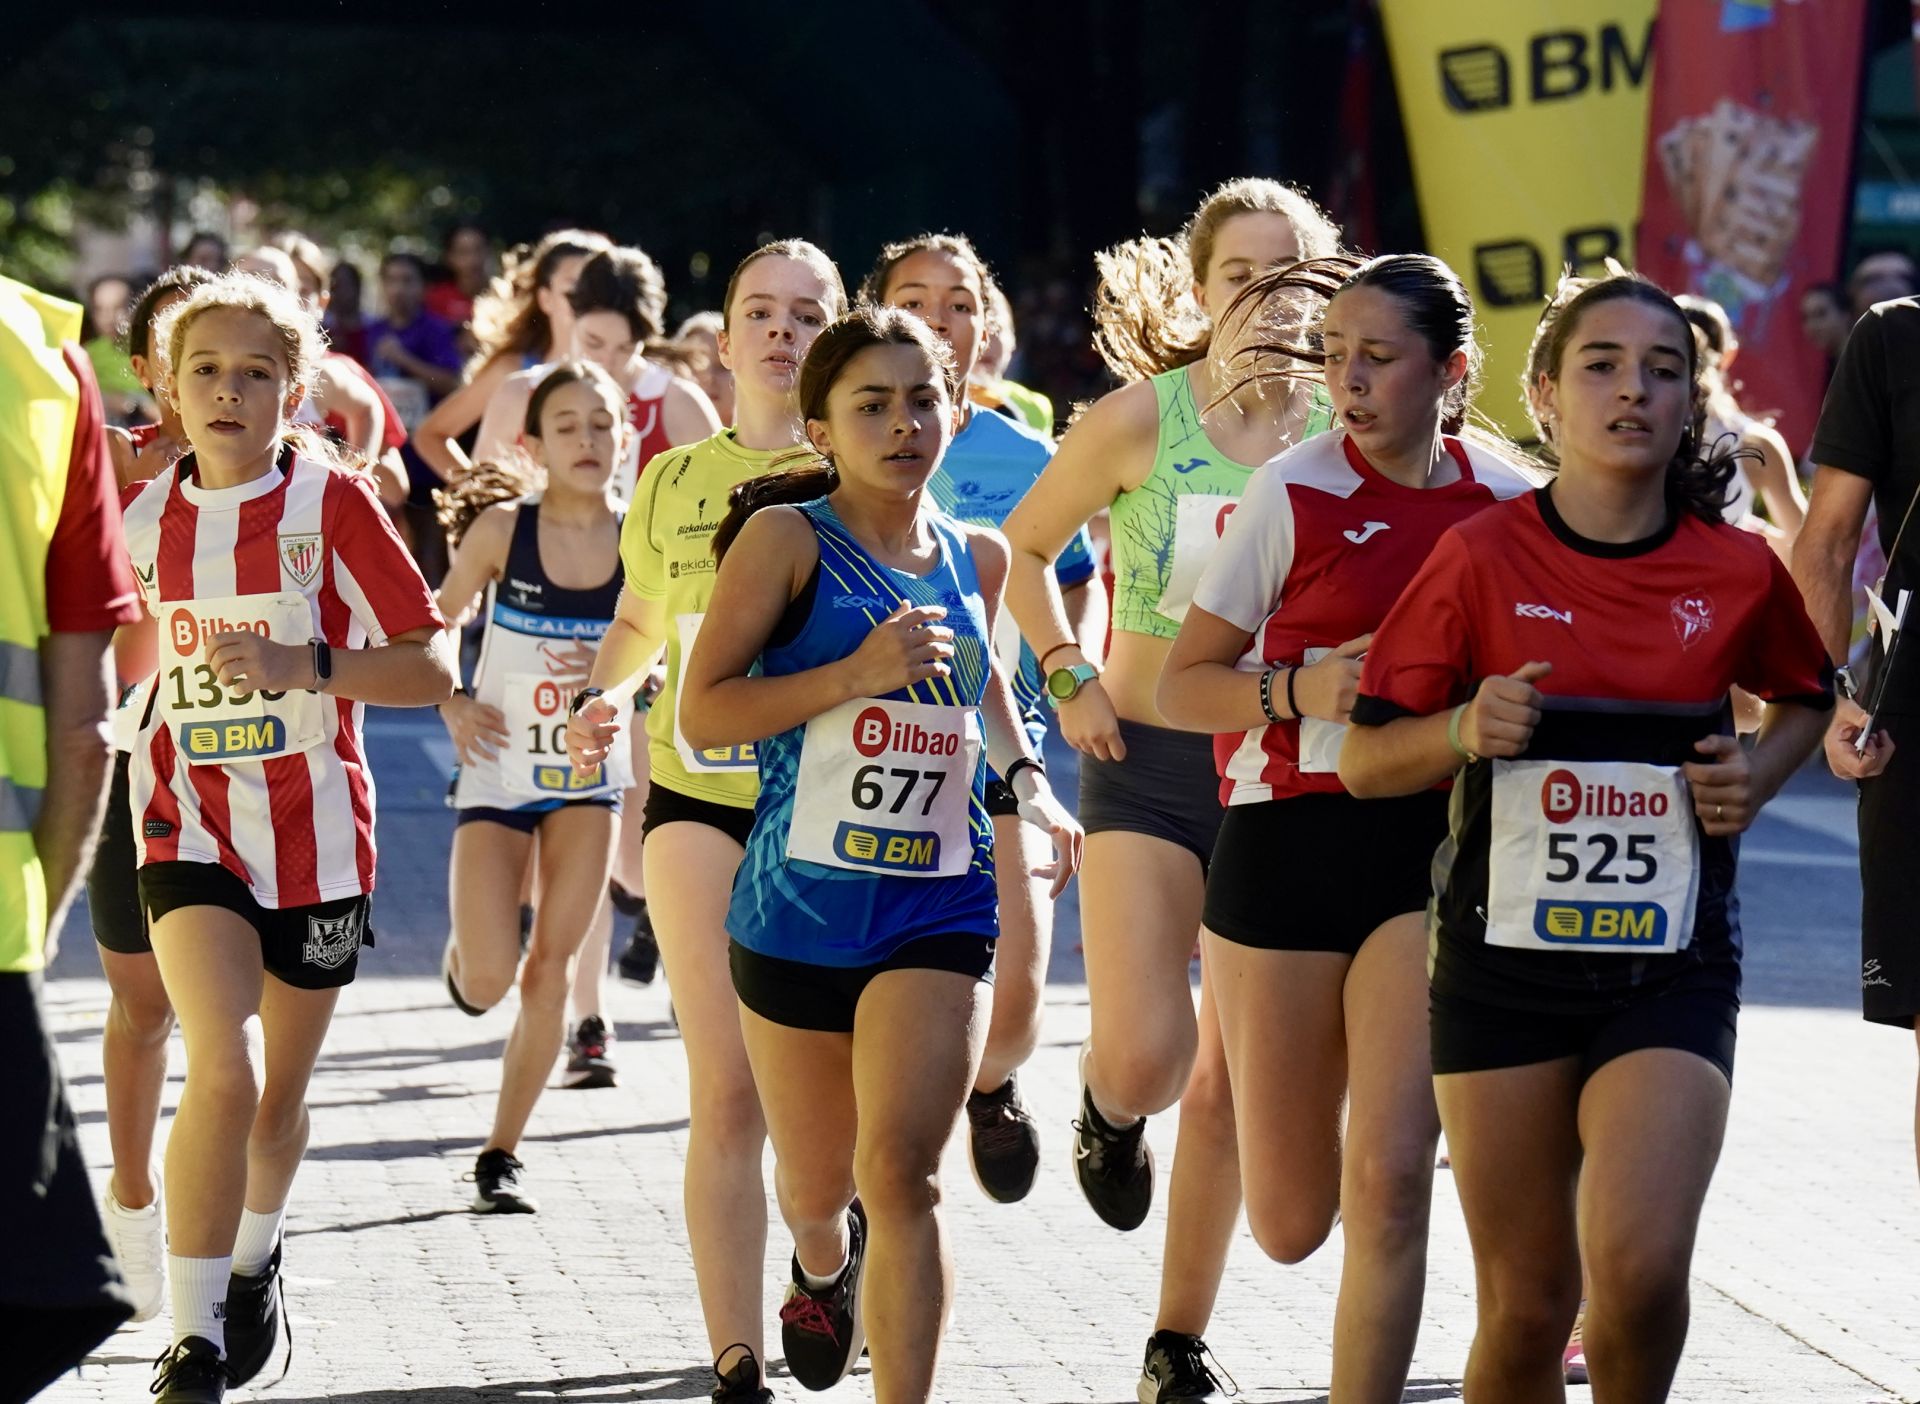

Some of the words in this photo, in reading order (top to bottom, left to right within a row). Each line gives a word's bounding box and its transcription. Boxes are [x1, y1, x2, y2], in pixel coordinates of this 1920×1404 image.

[1529, 24, 1657, 102] BM
[168, 662, 287, 710] 13
[225, 721, 274, 752] BM
[855, 708, 959, 757] Bilbao
[851, 764, 947, 816] 677
[1543, 772, 1668, 822] Bilbao
[883, 836, 934, 865] BM
[1546, 832, 1658, 885] 525
[1591, 908, 1656, 939] BM
[1863, 975, 1892, 989] piuk
